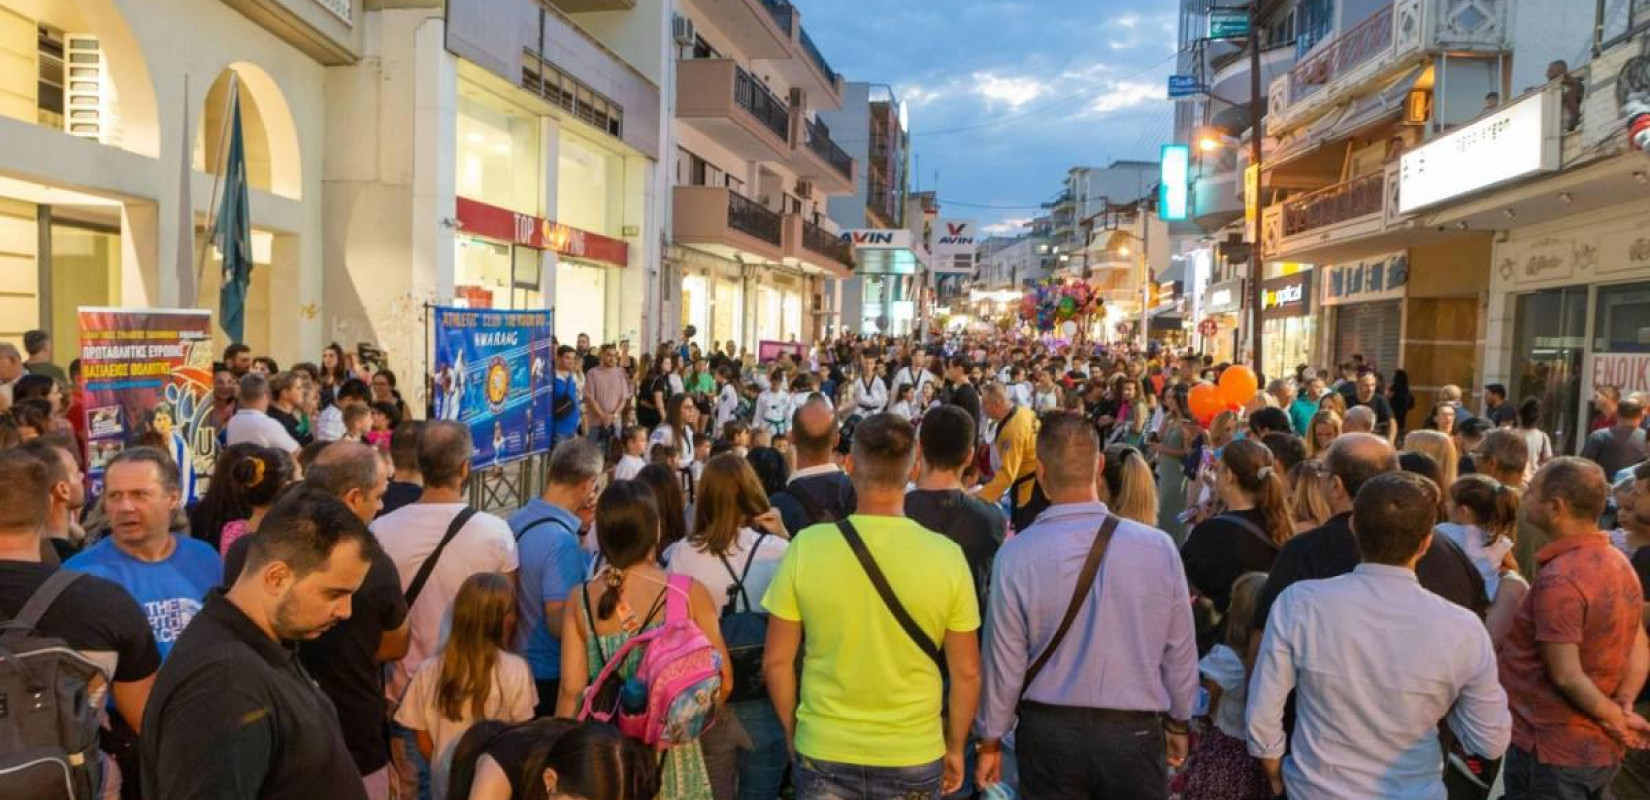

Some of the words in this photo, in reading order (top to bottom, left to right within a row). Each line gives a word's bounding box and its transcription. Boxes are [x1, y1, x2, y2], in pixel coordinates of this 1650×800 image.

[514, 212, 534, 246] TOP
[840, 231, 893, 244] AVIN
[938, 236, 973, 245] AVIN
[144, 599, 180, 616] THE
